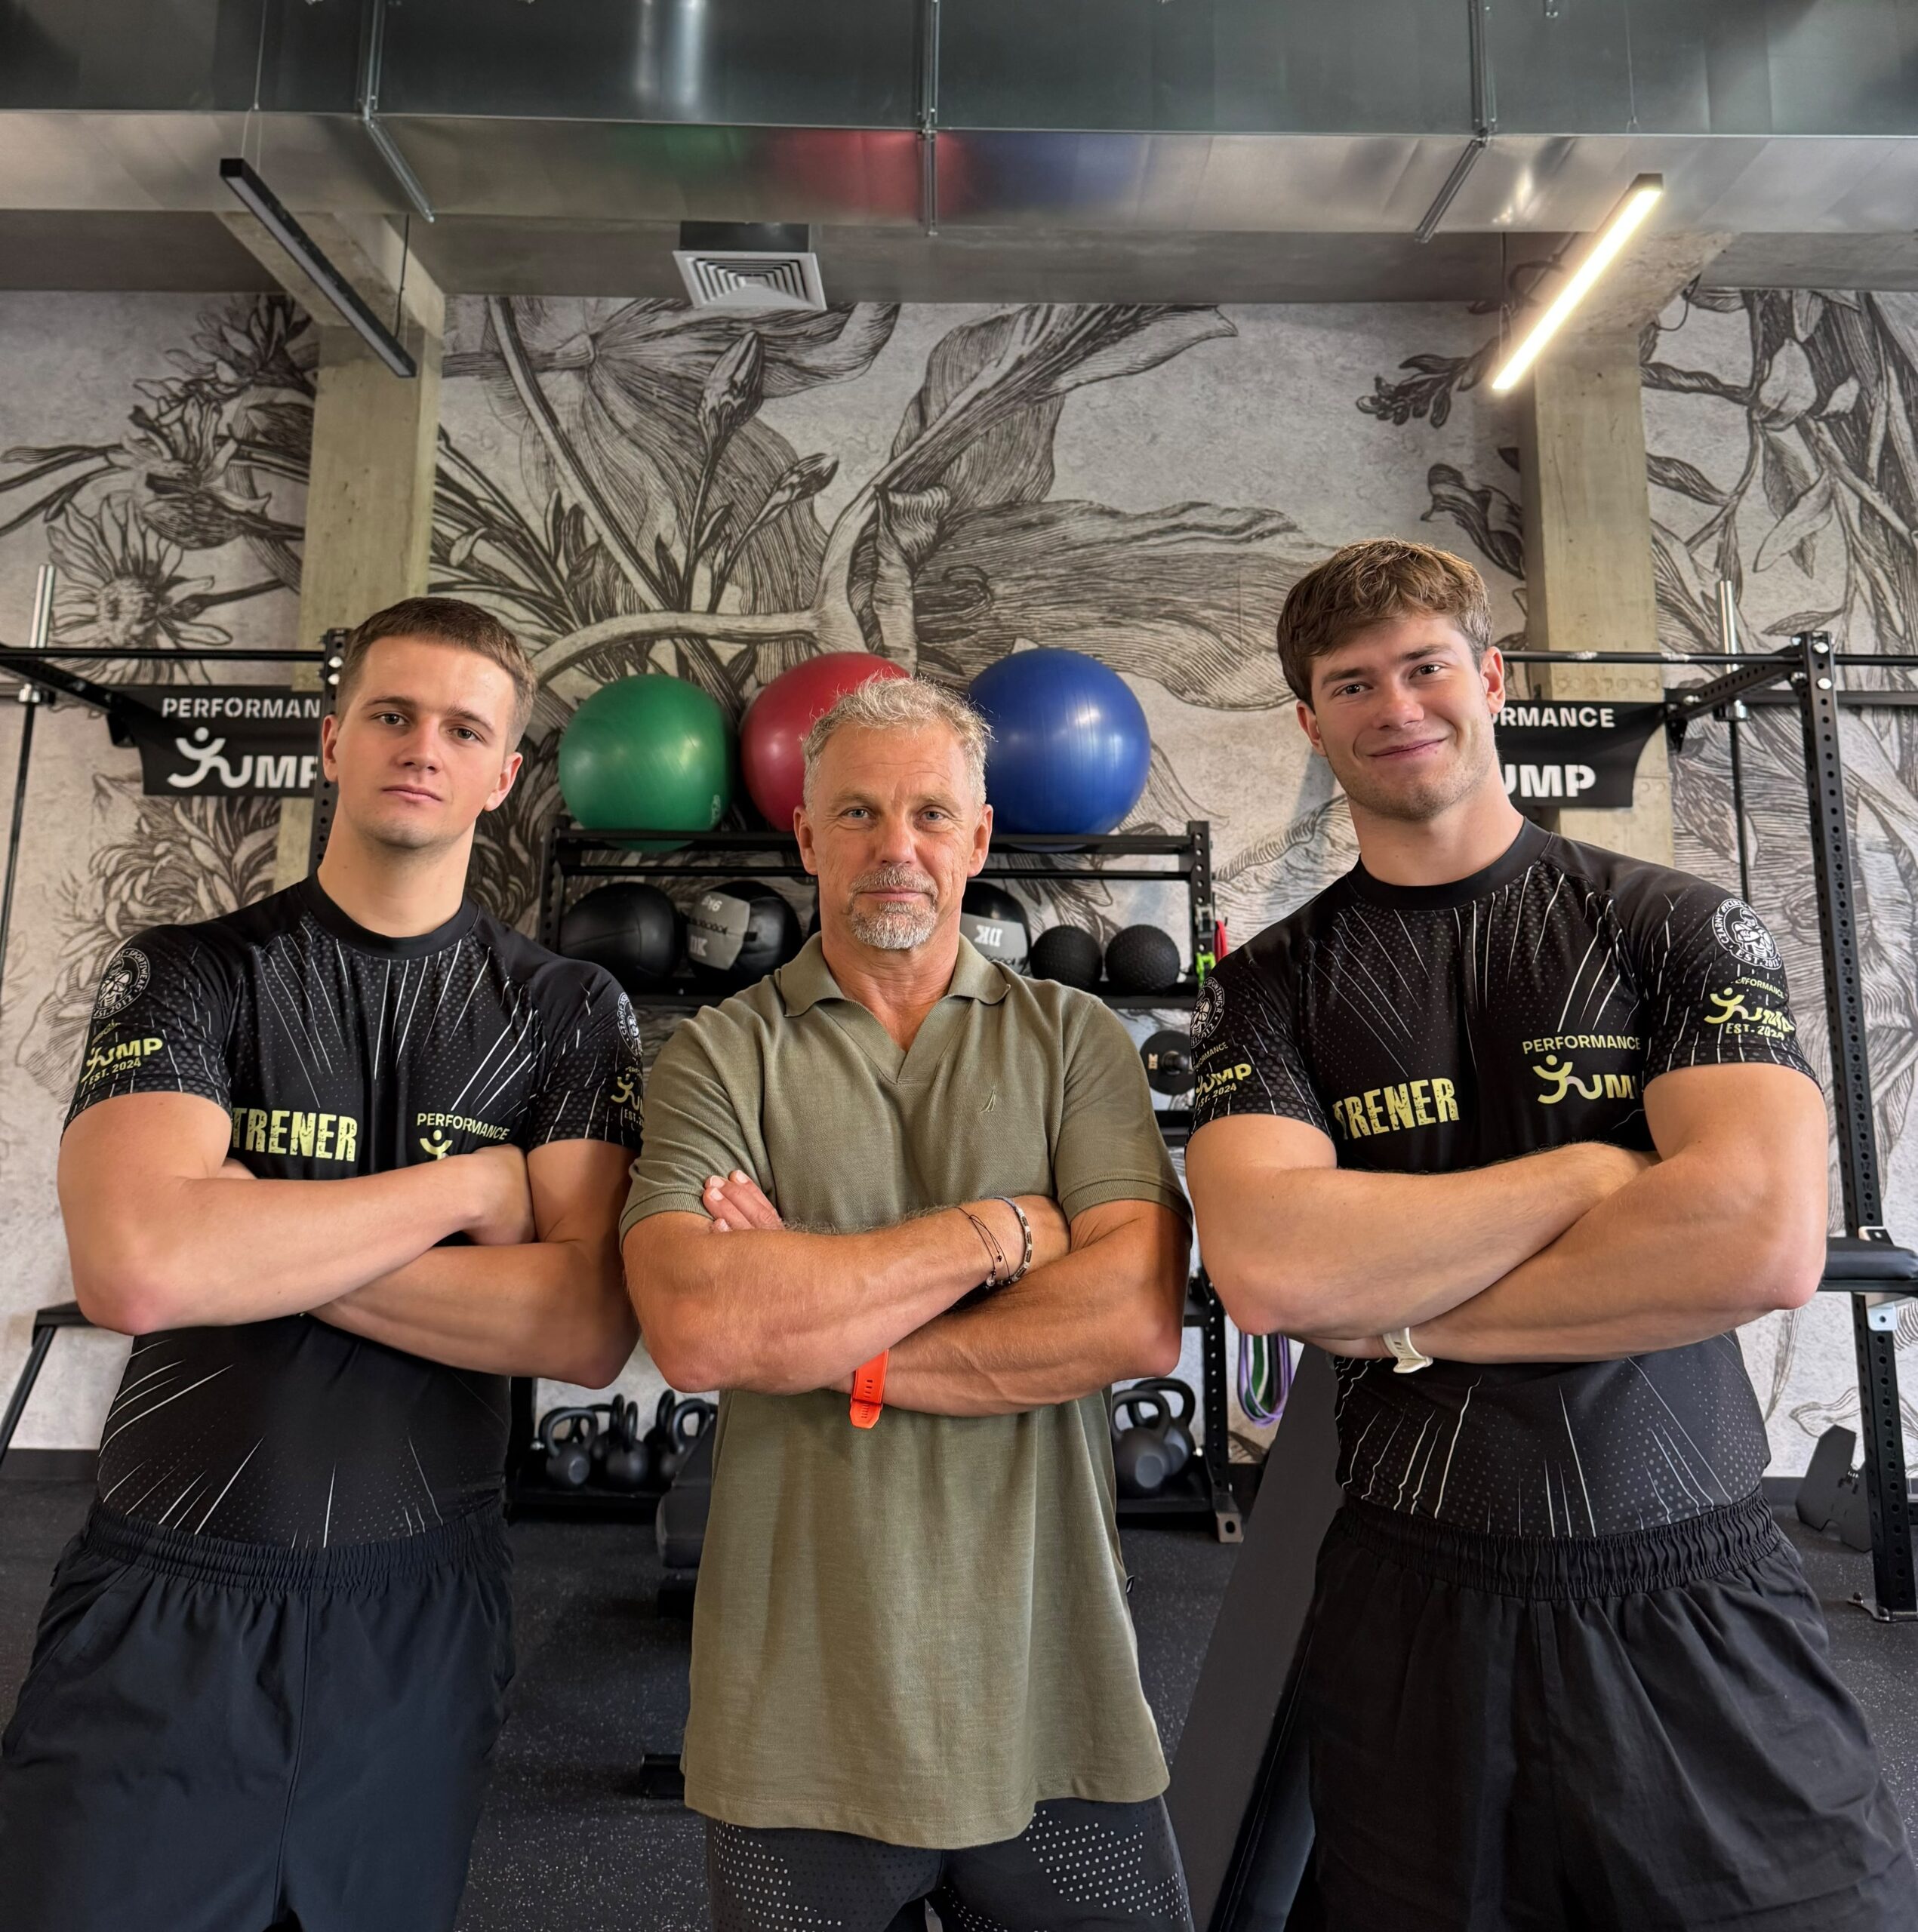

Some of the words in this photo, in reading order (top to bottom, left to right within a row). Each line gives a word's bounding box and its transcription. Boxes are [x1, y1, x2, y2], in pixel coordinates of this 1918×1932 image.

[162, 697, 321, 718] PERFORMAN
[1493, 706, 1615, 728] RMANCE
[1504, 764, 1596, 798] UMP
[974, 924, 1002, 947] DK
[1522, 1035, 1641, 1054] PERFORMANCE
[113, 1057, 142, 1074] 2024
[1212, 1082, 1237, 1098] 2024
[1532, 1054, 1639, 1104] JUM
[1332, 1078, 1461, 1140] TRENER
[232, 1107, 358, 1162] TRENER
[417, 1112, 511, 1140] PERFORMANCE
